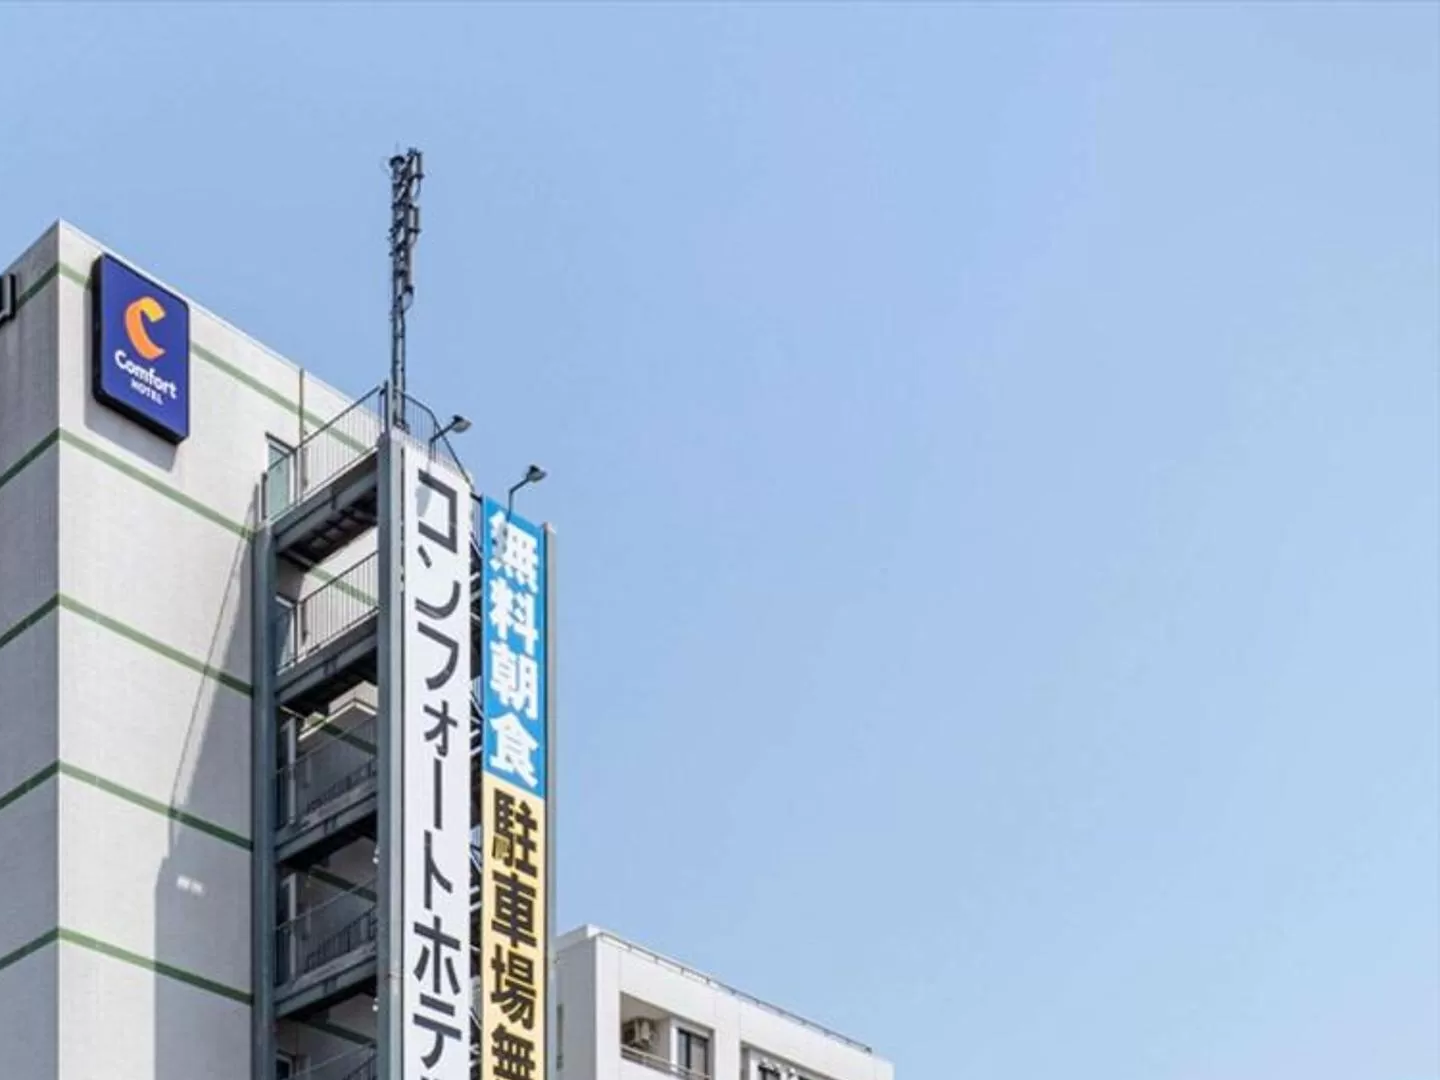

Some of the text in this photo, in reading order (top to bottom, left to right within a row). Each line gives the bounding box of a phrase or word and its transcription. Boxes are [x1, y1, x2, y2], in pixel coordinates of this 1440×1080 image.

[114, 349, 177, 399] Comfort
[488, 510, 539, 788] 無料朝食
